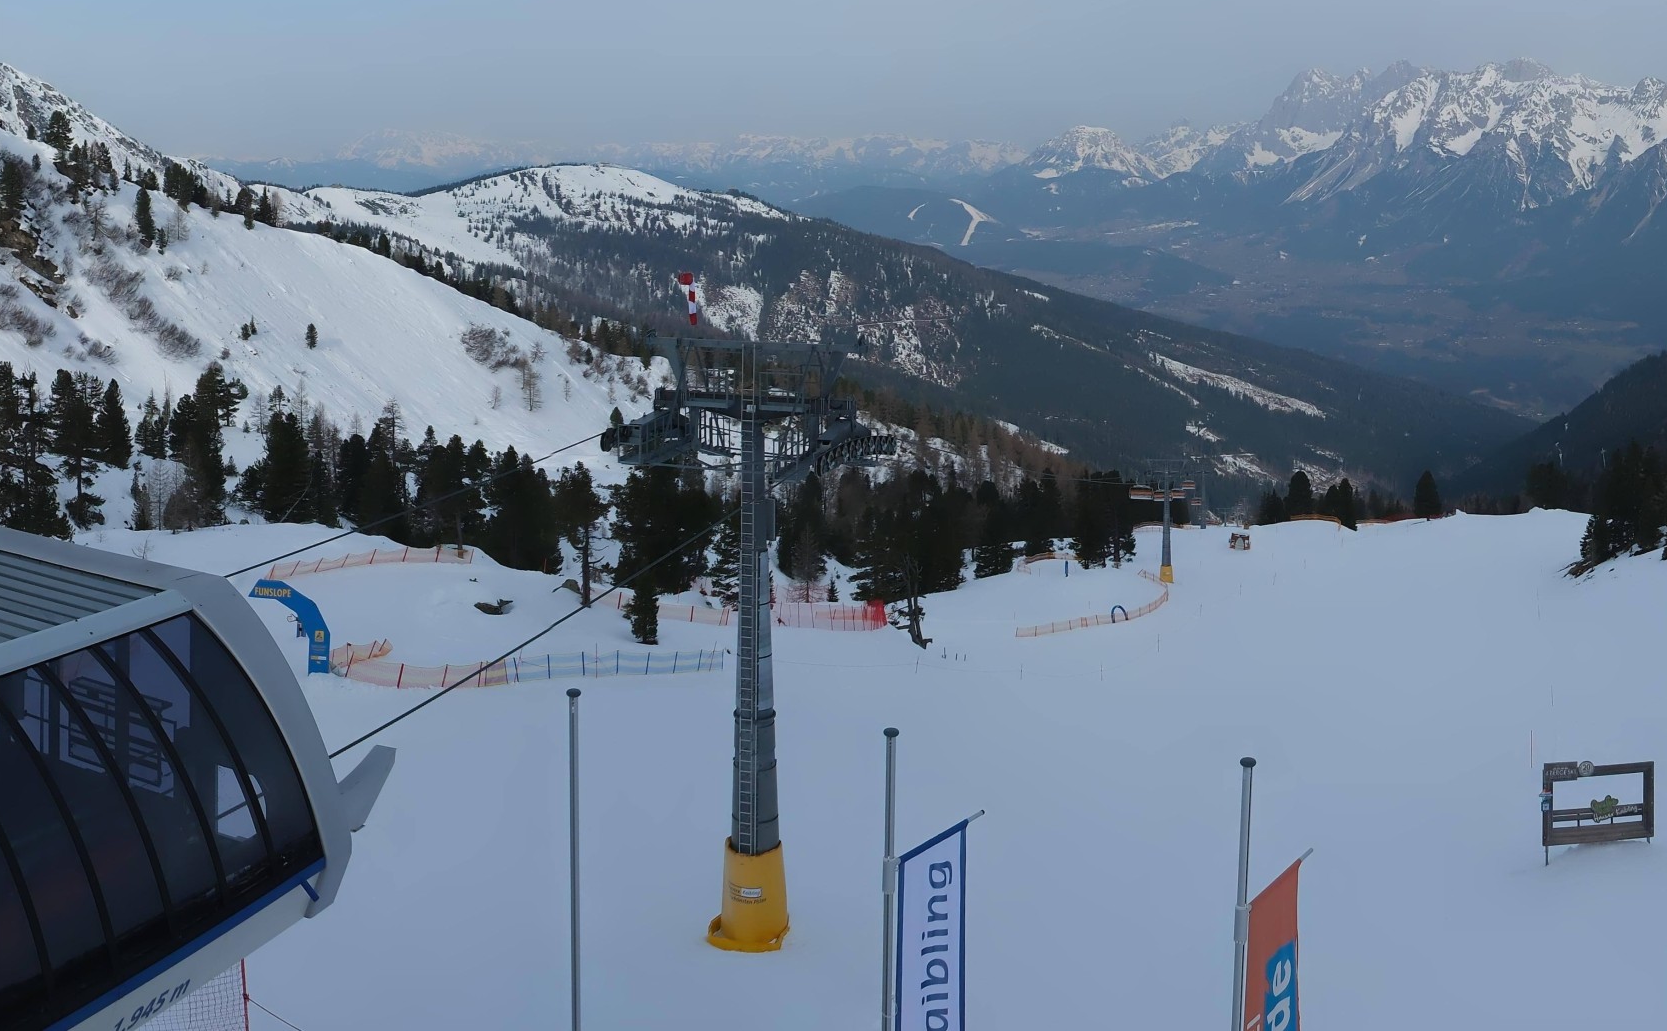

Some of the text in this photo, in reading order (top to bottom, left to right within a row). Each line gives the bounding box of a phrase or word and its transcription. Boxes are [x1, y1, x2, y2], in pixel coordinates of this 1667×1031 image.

[254, 586, 292, 598] FUNSLOPE
[114, 979, 191, 1031] 1.945 m
